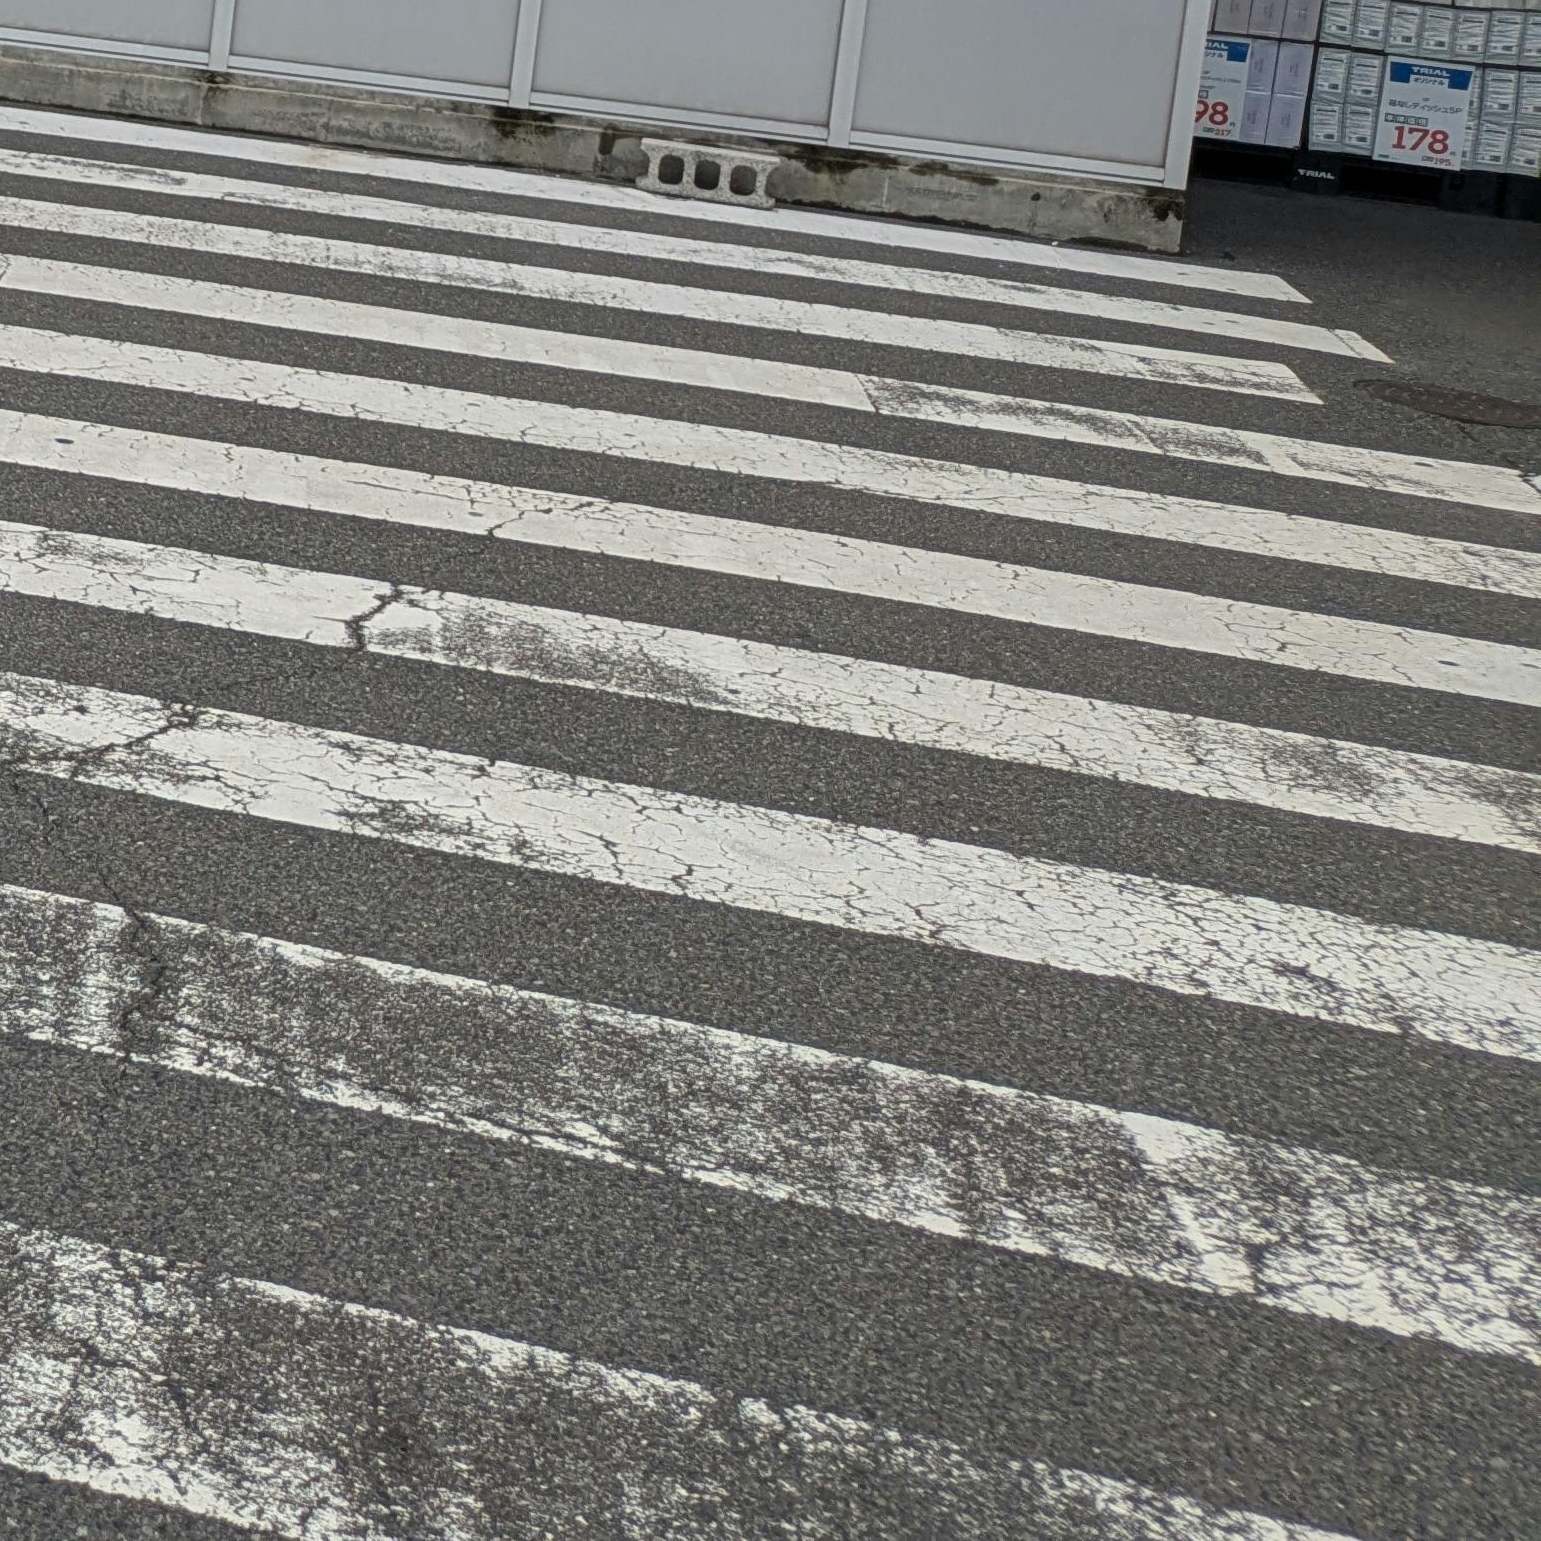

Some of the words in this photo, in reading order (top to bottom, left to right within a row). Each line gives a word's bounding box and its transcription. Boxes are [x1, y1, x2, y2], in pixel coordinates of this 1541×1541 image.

[1410, 66, 1450, 77] TRIAL
[1391, 125, 1449, 155] 178
[1297, 168, 1336, 180] TRIAL
